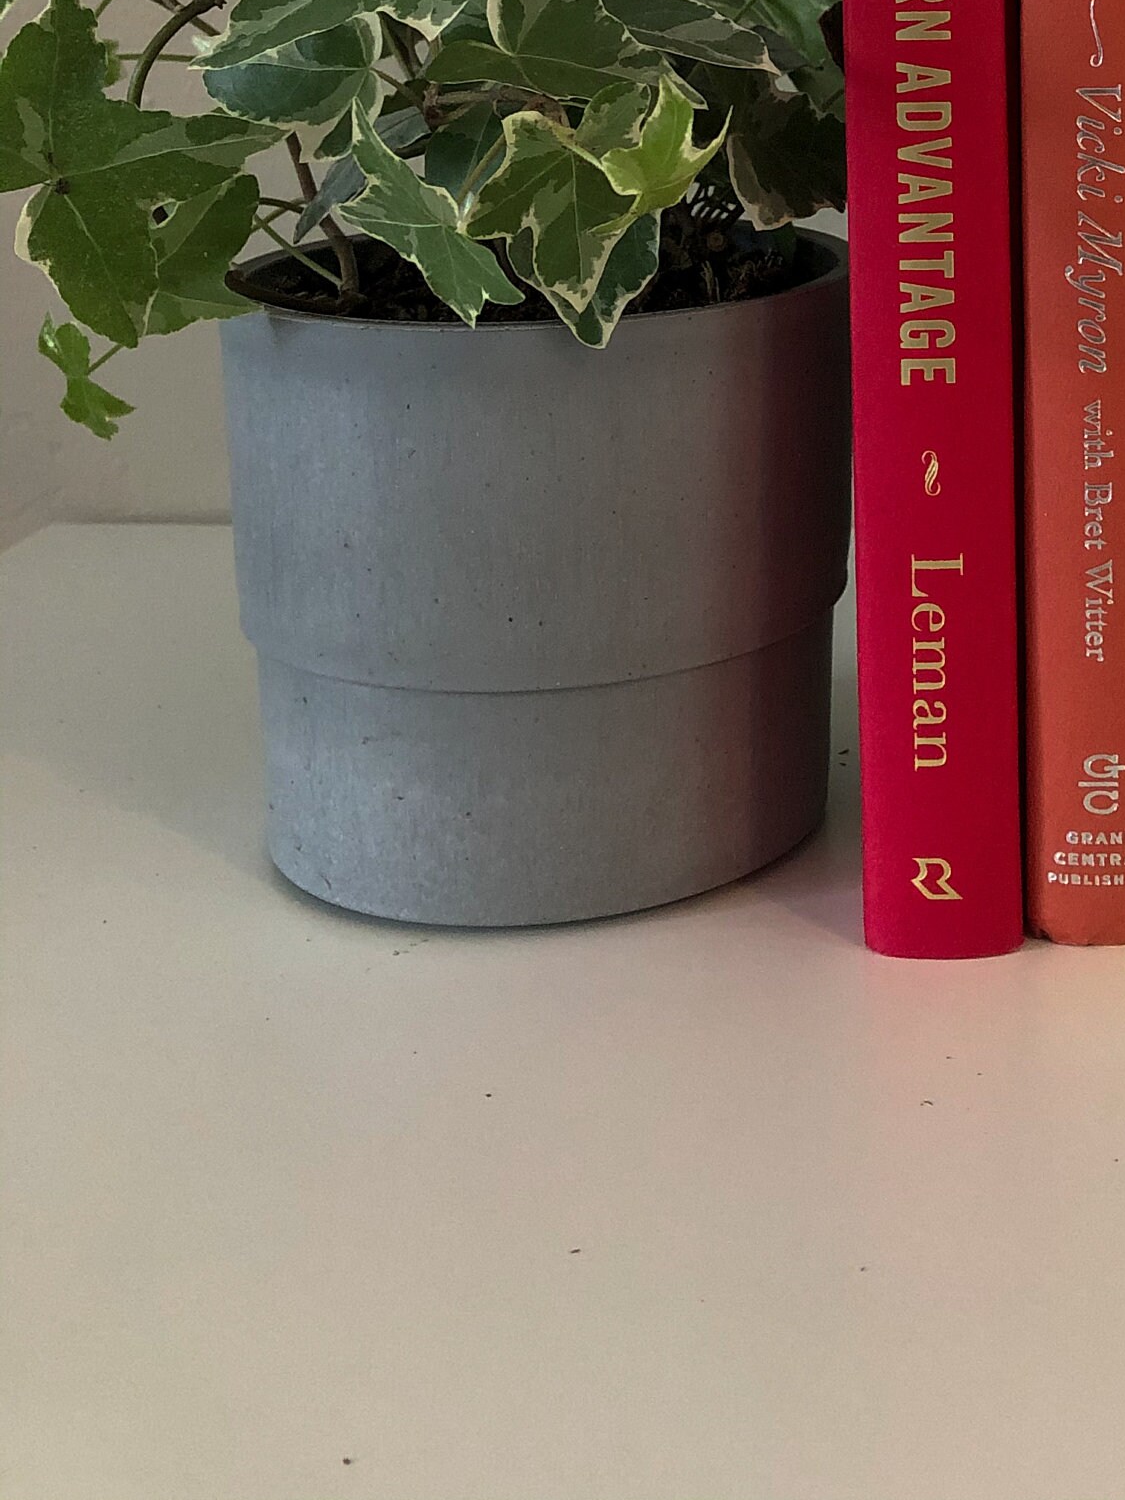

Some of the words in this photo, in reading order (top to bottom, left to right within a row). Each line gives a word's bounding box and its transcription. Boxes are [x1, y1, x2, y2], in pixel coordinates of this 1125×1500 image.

[1076, 83, 1125, 203] Vicki
[895, 62, 956, 386] ADVANTAGE
[1064, 211, 1122, 374] Myron
[1083, 400, 1114, 470] with
[1084, 482, 1112, 550] Bret
[909, 552, 964, 773] Leman
[1084, 559, 1115, 662] Witter
